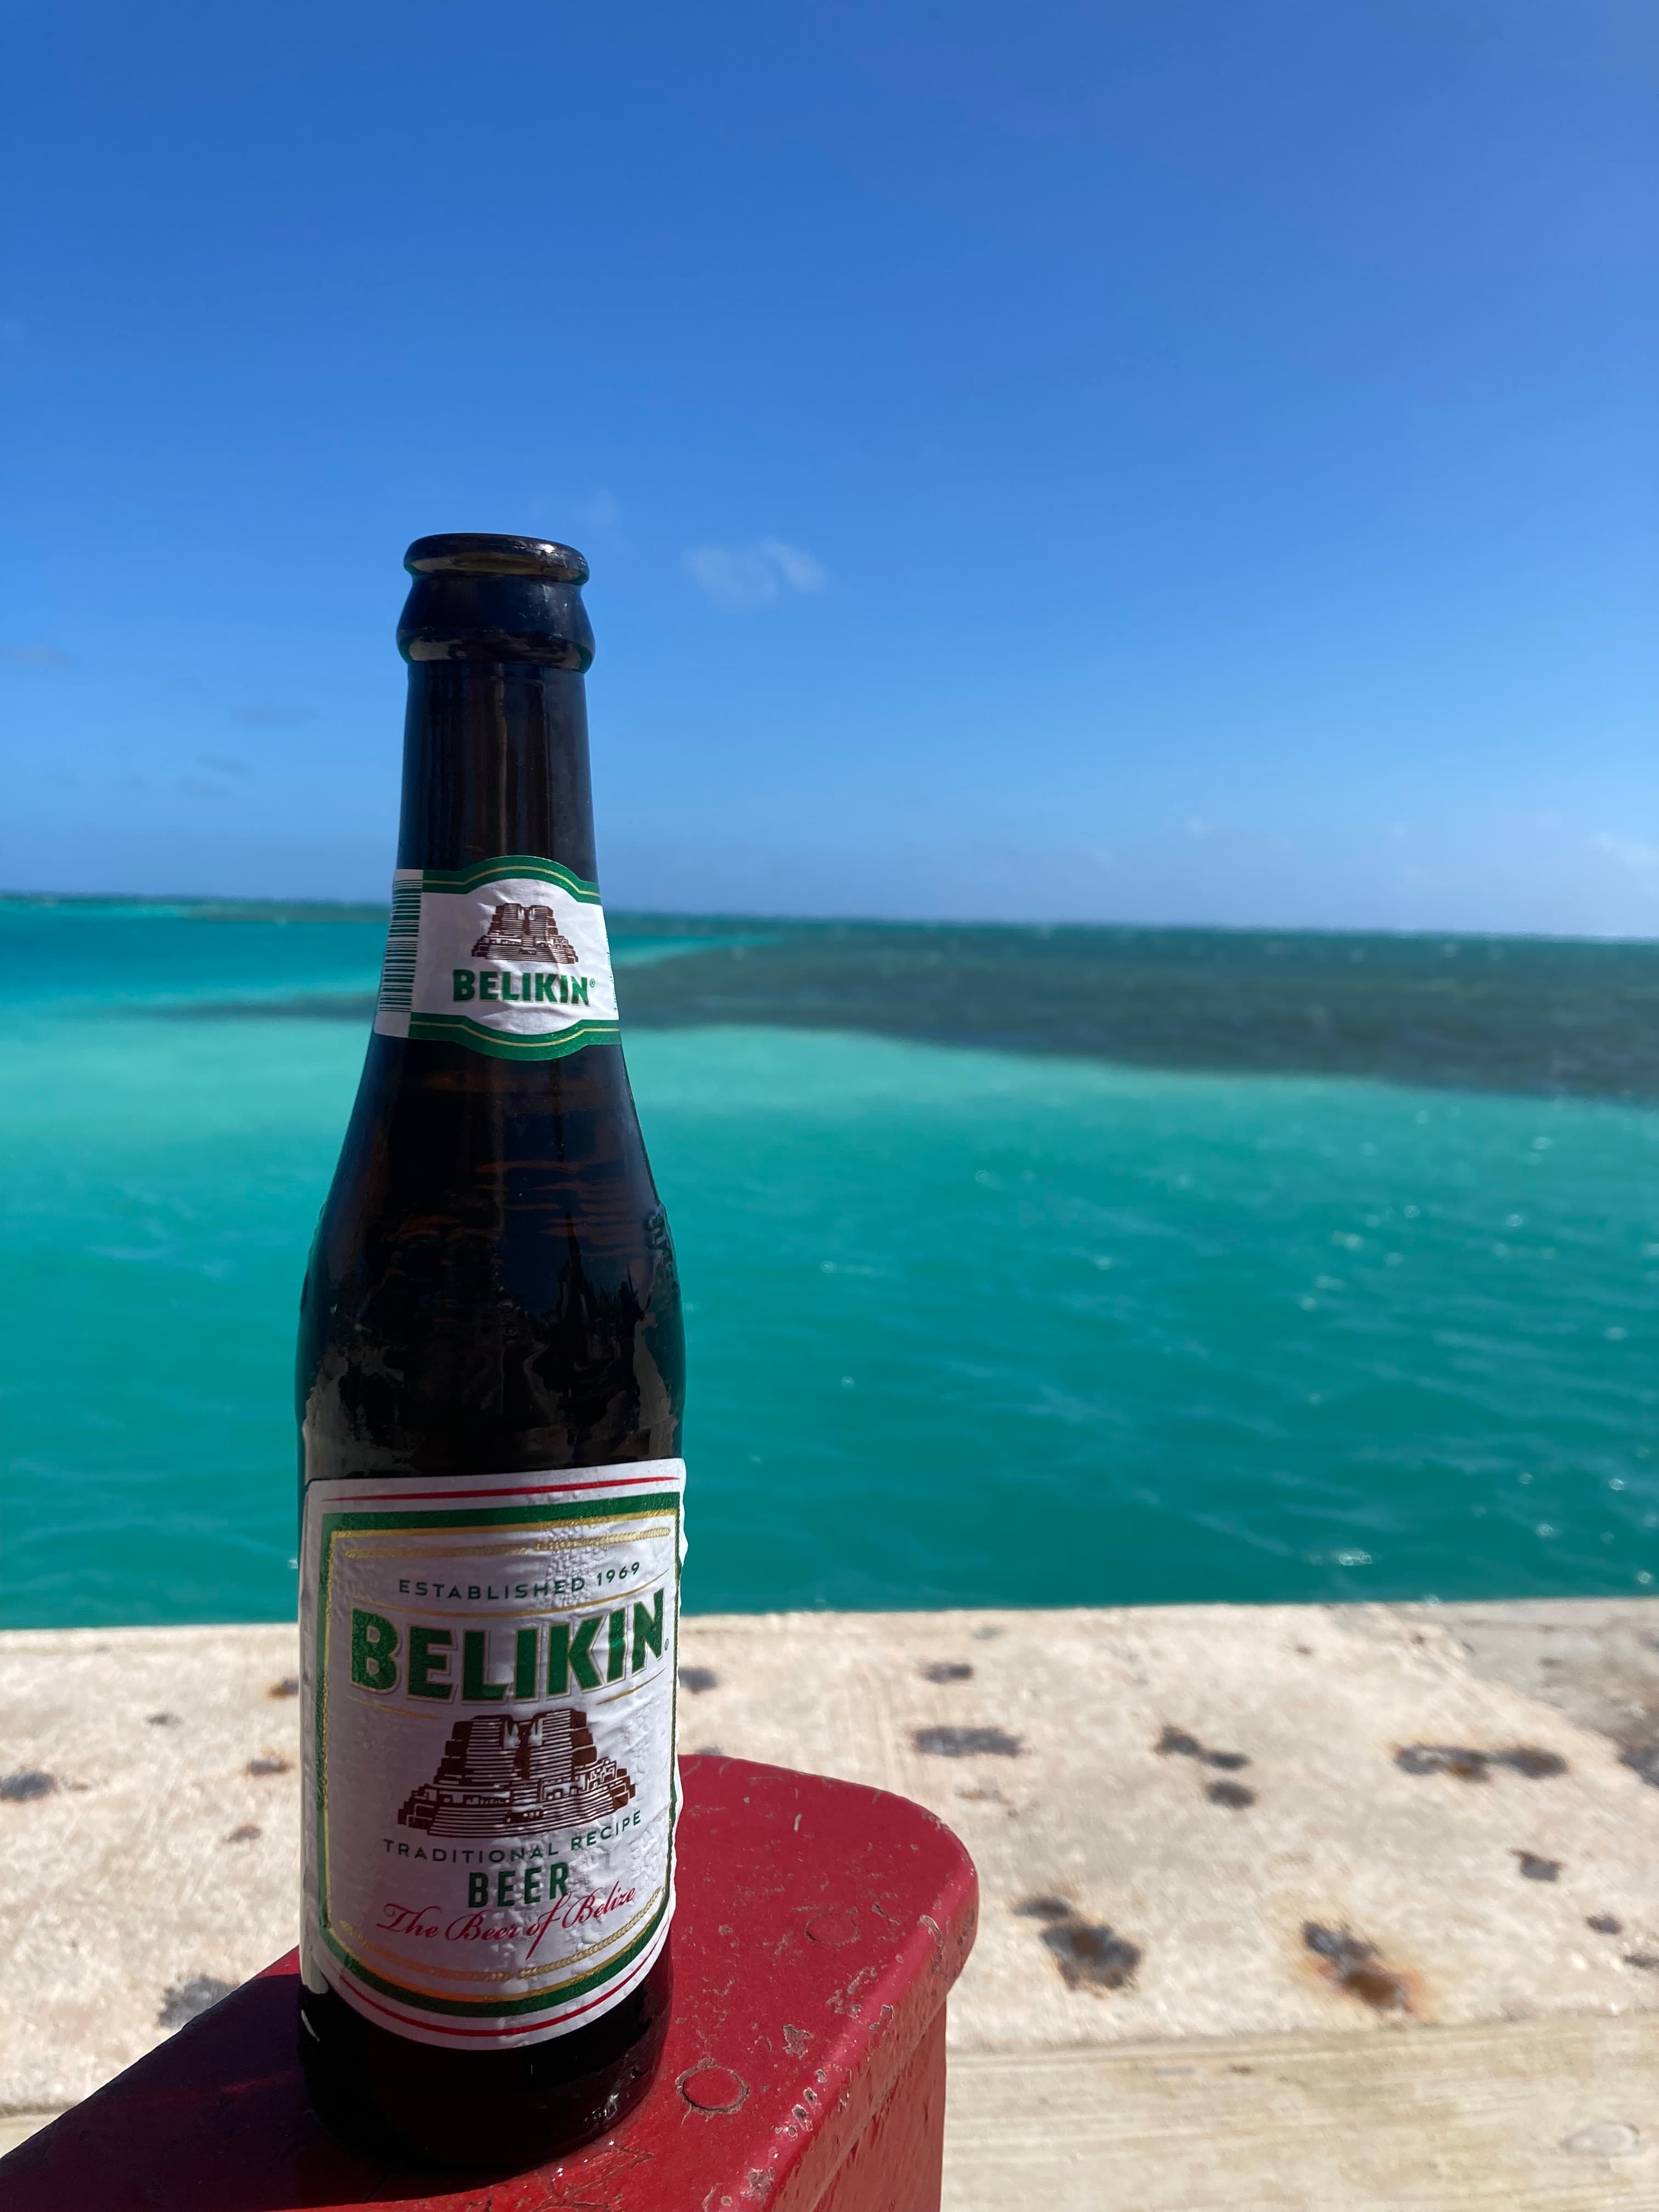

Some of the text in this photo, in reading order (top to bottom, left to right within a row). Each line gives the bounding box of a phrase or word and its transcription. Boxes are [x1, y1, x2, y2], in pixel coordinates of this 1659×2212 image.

[399, 1561, 641, 1599] ESTABLISHED 1969
[383, 1810, 641, 1864] TRADITIONAL RECIPE
[467, 1861, 571, 1908] BEER
[376, 1881, 637, 1961] The Beer of Belize
